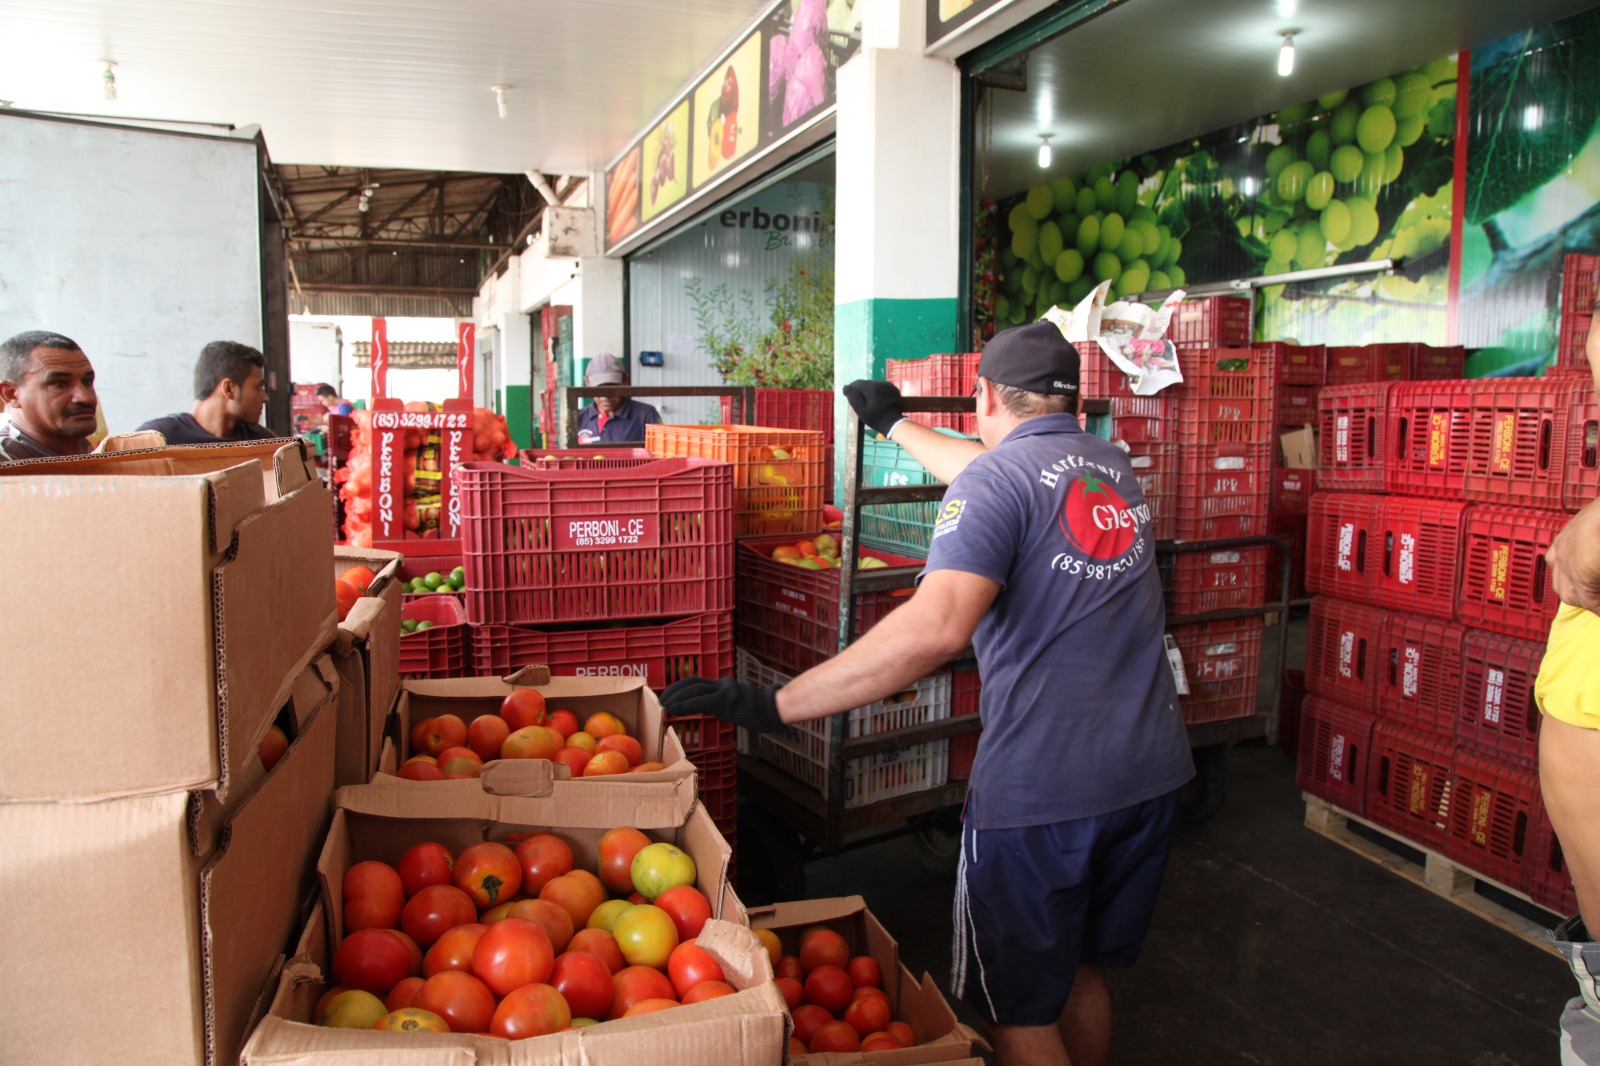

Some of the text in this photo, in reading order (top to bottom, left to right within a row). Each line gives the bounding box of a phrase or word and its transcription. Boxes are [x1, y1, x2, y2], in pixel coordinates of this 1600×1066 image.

[702, 206, 820, 233] erboni
[1432, 413, 1442, 425] CE
[1502, 415, 1514, 452] PERBONI
[1430, 430, 1440, 465] PERBONI
[1500, 458, 1511, 470] CE
[378, 431, 394, 537] PERBONI
[569, 520, 620, 538] PERBONI
[628, 519, 644, 536] CE
[1342, 523, 1354, 555] PERBONI
[1401, 533, 1411, 545] CE
[576, 535, 639, 546] (85) 3299 1722
[1341, 560, 1351, 571] CE
[1399, 549, 1409, 584] PERBONI
[1497, 545, 1509, 582] PERBONI
[1495, 587, 1505, 599] CE
[1344, 631, 1355, 663] PERBONI
[1405, 647, 1416, 658] CE
[1342, 667, 1351, 678] CE
[1403, 662, 1414, 696] PERBONI
